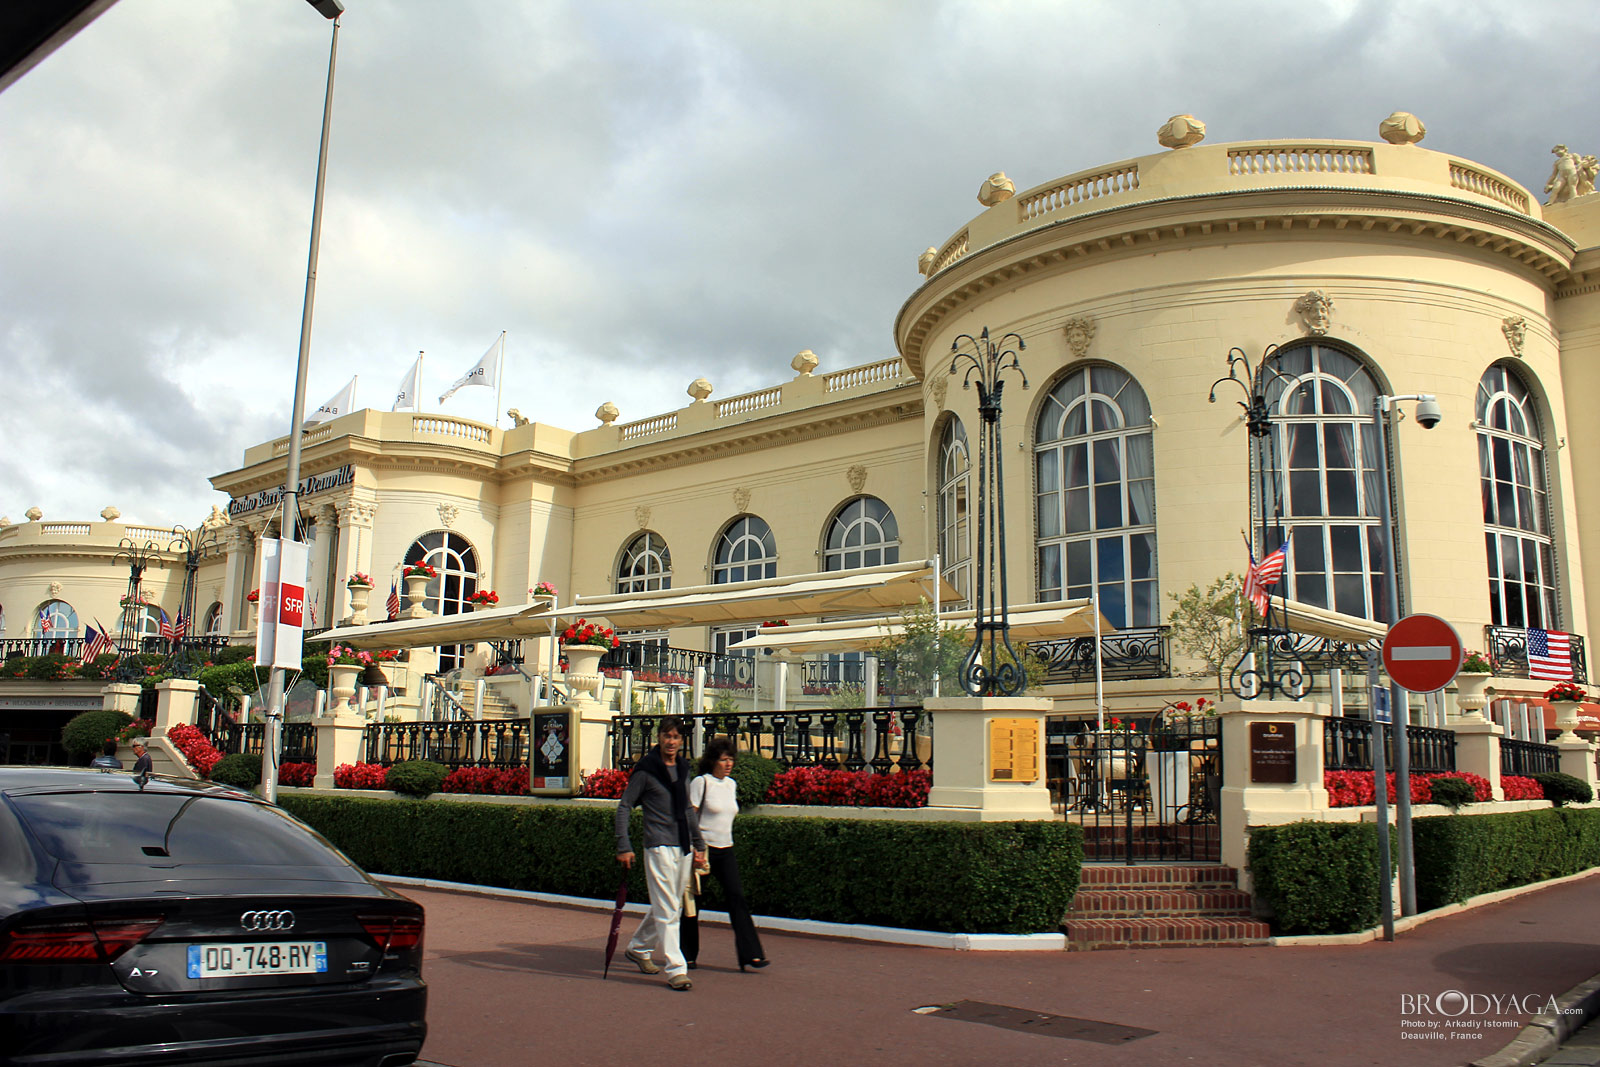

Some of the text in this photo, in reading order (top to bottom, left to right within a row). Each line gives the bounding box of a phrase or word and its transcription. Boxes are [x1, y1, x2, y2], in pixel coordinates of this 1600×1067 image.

[228, 495, 258, 516] Casino
[305, 464, 355, 496] Deauville
[284, 596, 303, 614] SFR
[128, 967, 159, 978] A7
